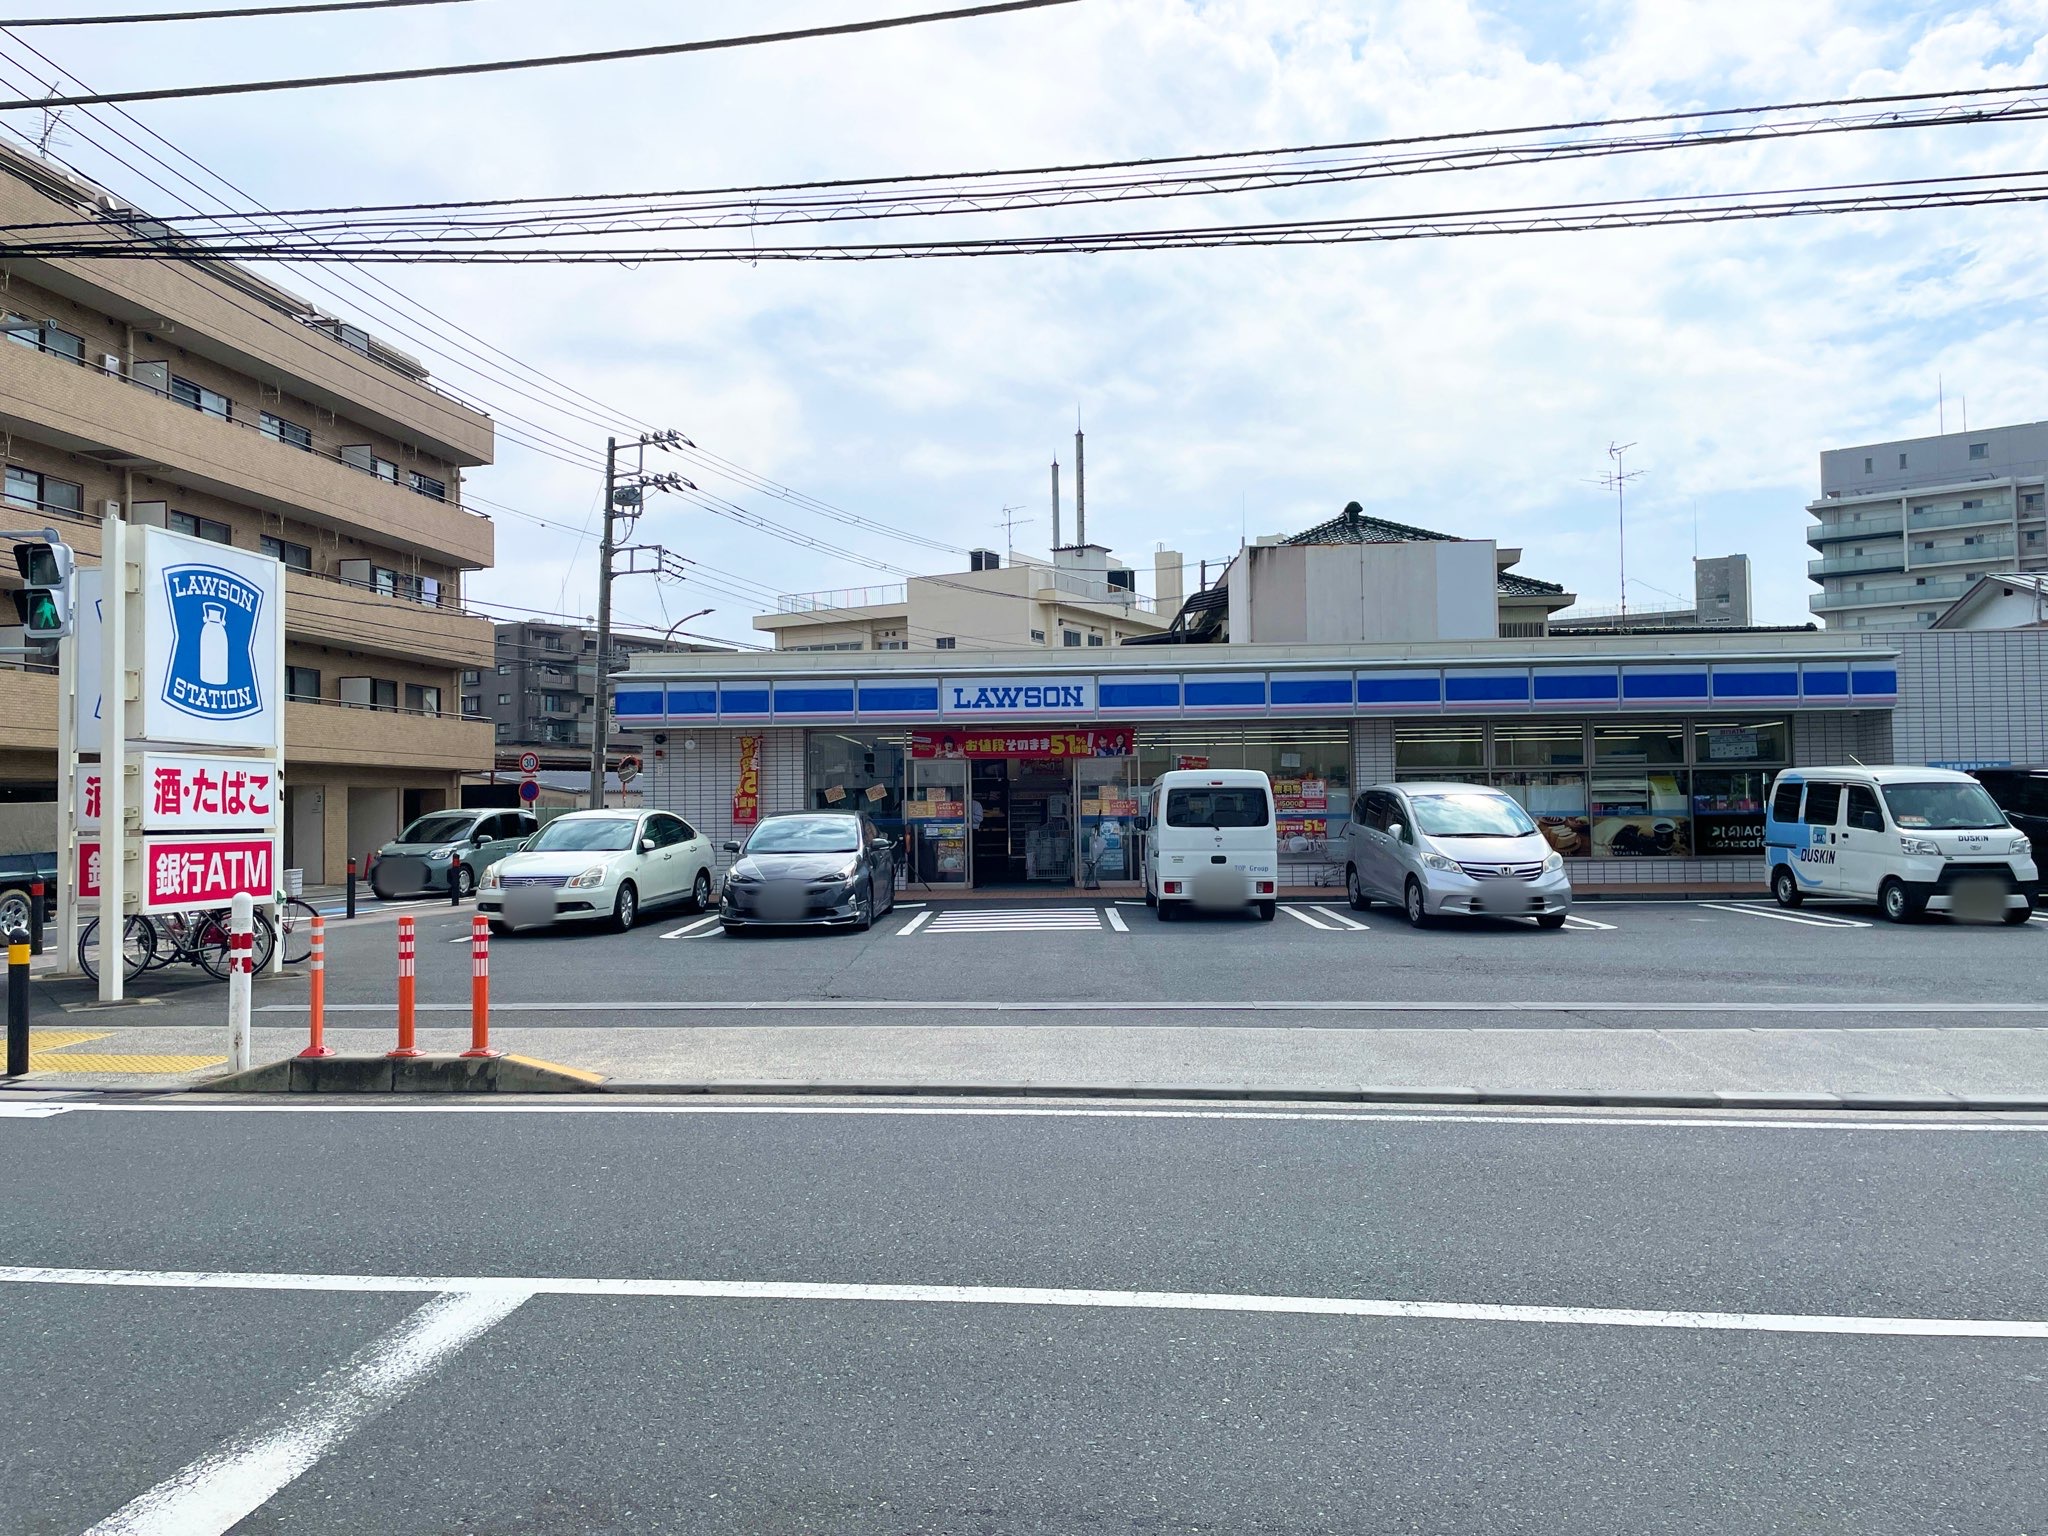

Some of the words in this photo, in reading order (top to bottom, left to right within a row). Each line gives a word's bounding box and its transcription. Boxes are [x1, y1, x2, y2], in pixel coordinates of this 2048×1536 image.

[173, 575, 255, 612] LAWSON
[173, 677, 252, 709] STATION
[953, 686, 1084, 709] LAWSON
[523, 758, 535, 768] 30
[153, 767, 269, 815] 酒・たばこ
[1801, 848, 1836, 864] DUSKIN
[155, 849, 268, 896] 銀行ATM
